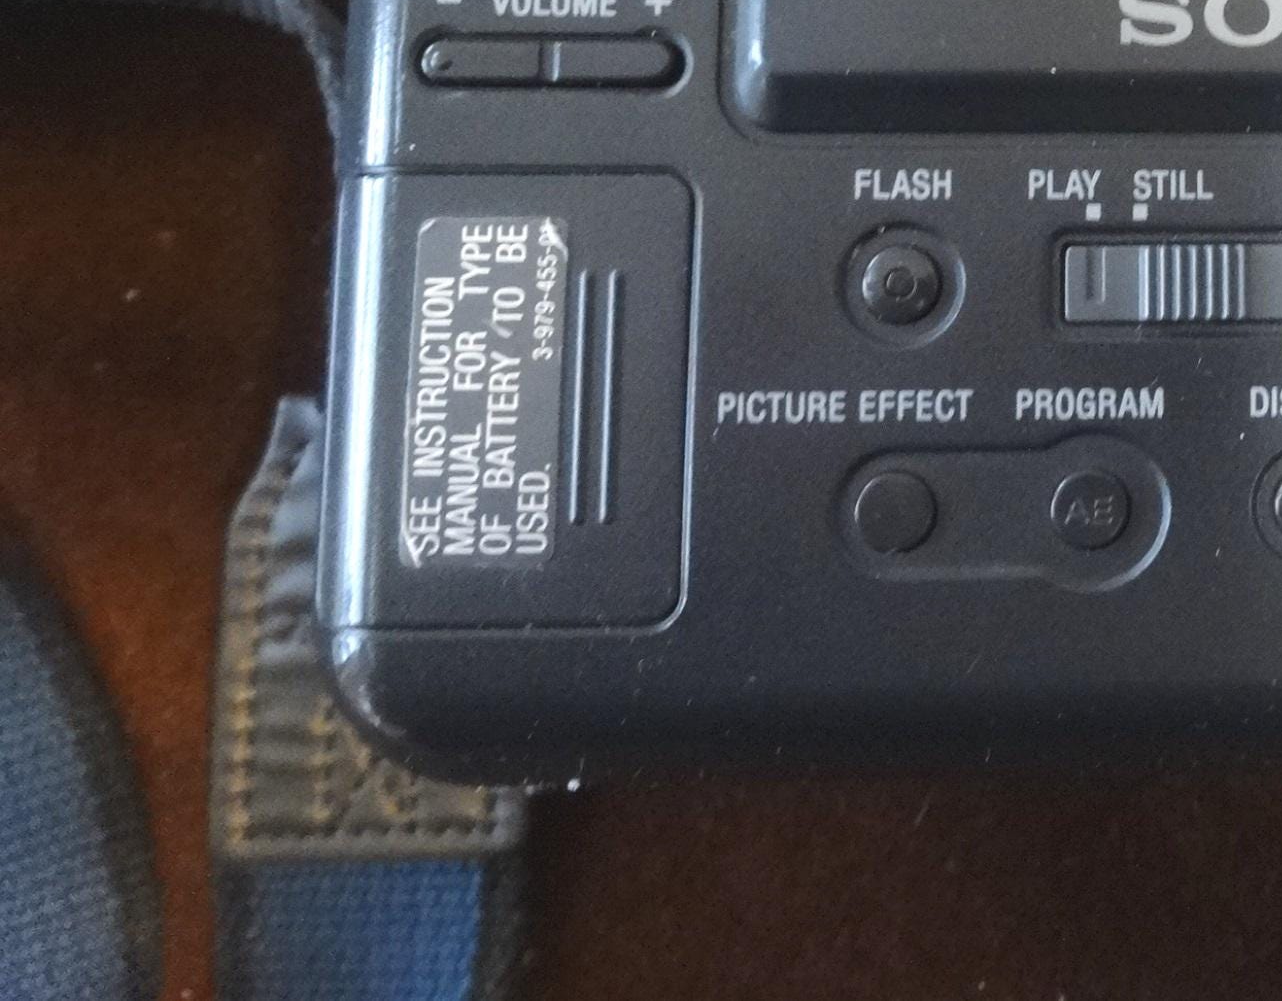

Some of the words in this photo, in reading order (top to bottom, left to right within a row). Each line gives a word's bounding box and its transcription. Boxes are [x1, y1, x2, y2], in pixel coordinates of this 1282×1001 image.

[853, 168, 953, 201] FLASH
[1027, 169, 1102, 200] PLAY
[1132, 169, 1214, 201] STILL
[458, 224, 494, 300] TYPE
[495, 224, 529, 263] BE
[491, 285, 525, 323] TO
[412, 276, 456, 478] INSTRUCTION
[453, 330, 488, 392] FOR
[482, 351, 522, 489] BATTERY
[716, 390, 847, 424] PICTURE
[858, 390, 973, 423] EFFECT
[1014, 388, 1165, 422] PROGRAM
[443, 422, 483, 556] MANUAL
[515, 462, 551, 556] USED.
[408, 494, 442, 559] SEE
[478, 513, 512, 556] OF
